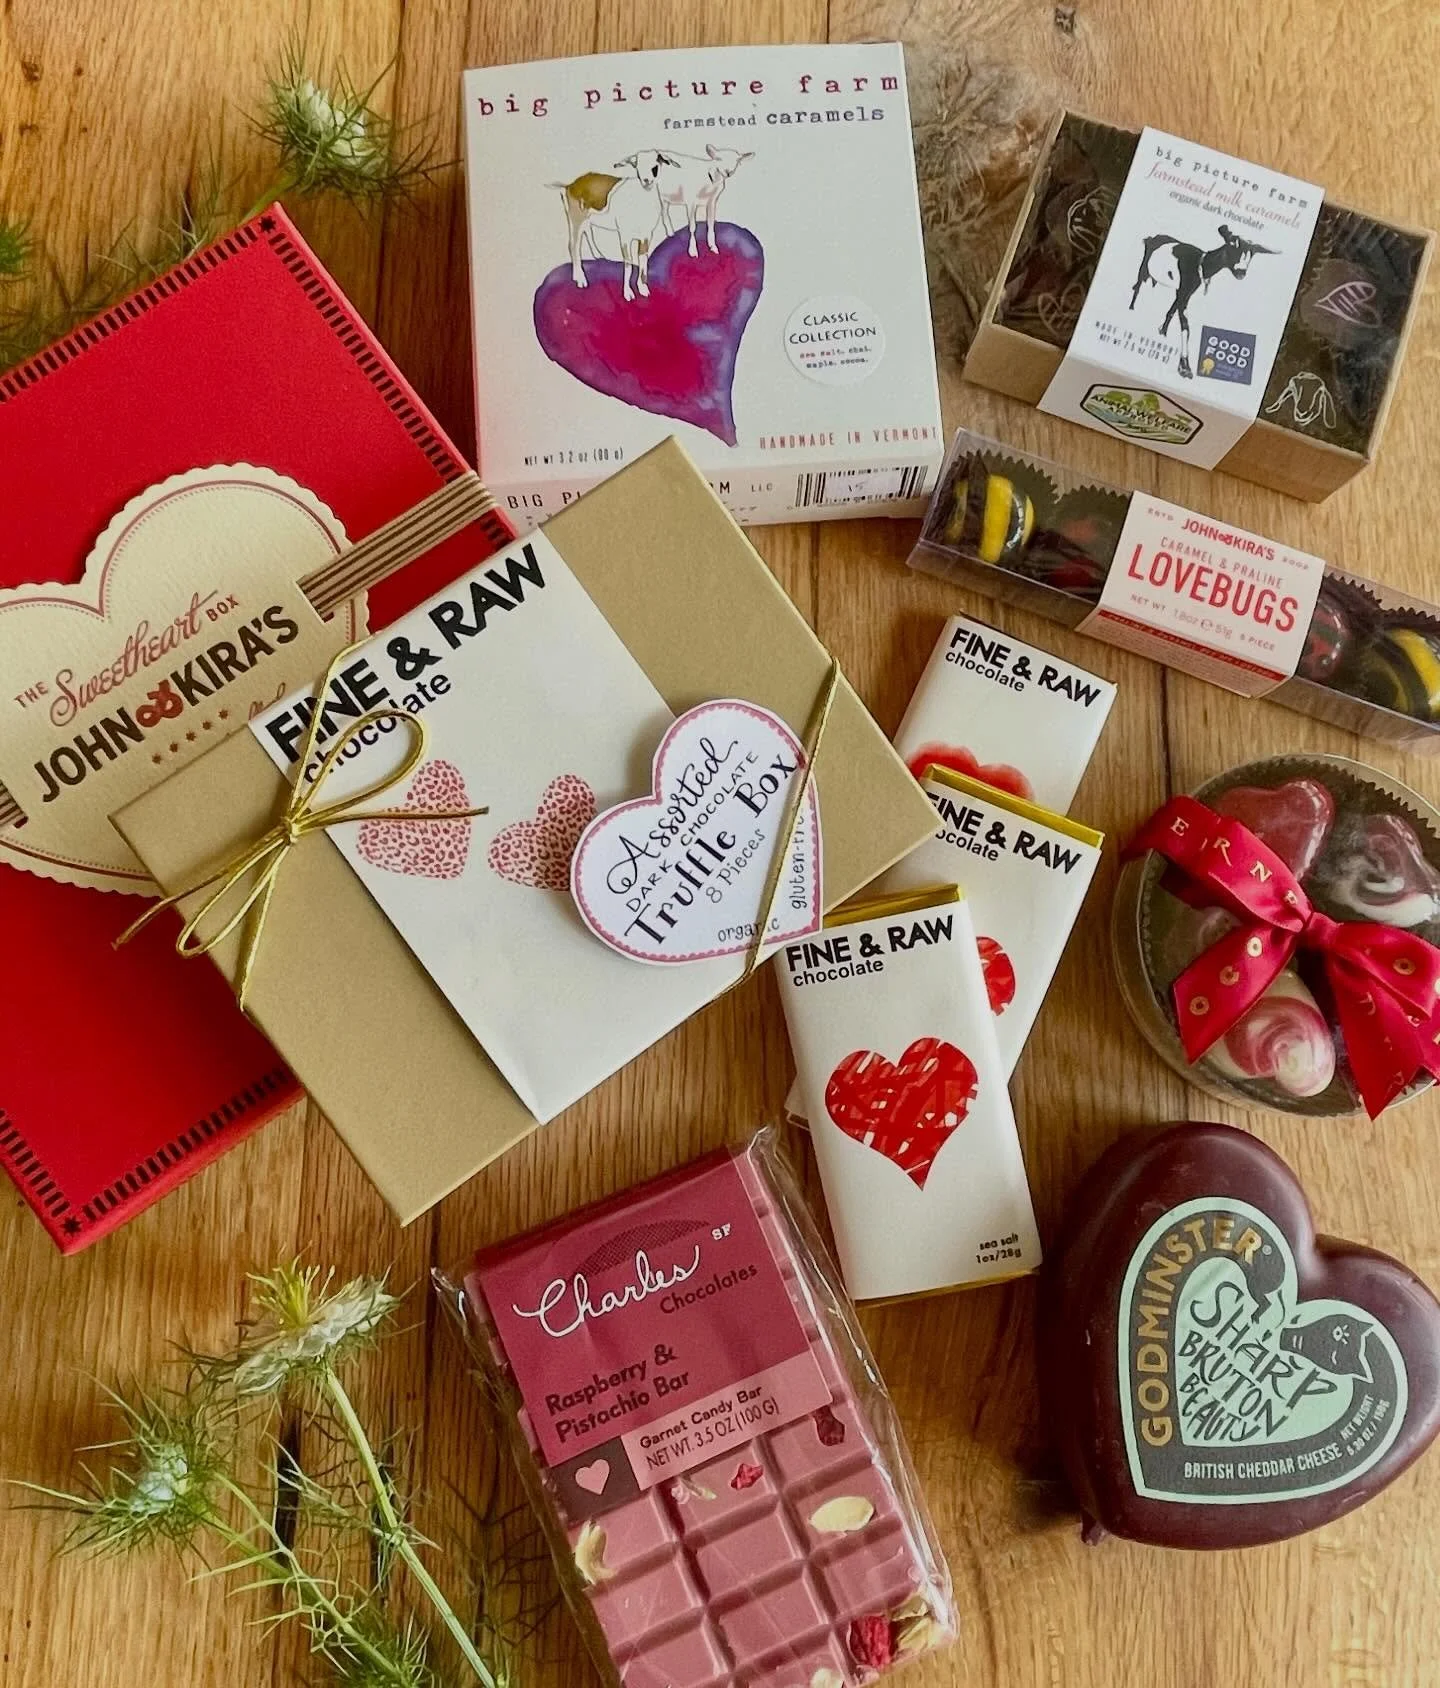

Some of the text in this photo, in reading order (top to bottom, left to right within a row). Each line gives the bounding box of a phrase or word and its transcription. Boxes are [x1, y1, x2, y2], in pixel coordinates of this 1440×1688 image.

[479, 73, 899, 117] big picture farm
[663, 106, 885, 131] farmstead caramels
[1146, 162, 1302, 230] farmstead milk caramels
[1156, 146, 1308, 209] big picture farm
[1169, 190, 1265, 230] organic dark chocolate
[789, 327, 877, 345] COLLECTION
[803, 312, 859, 326] CLASSIC
[1205, 346, 1248, 368] FOOD
[1208, 336, 1250, 358] GOOD
[524, 455, 538, 466] NET
[759, 426, 937, 450] HANDMADE IN VERMONT
[507, 493, 544, 510] BIG
[751, 482, 773, 493] LLC
[1127, 543, 1299, 632] LOVEBUGS
[1161, 535, 1284, 589] CARAMEL & PRALINE
[1130, 594, 1149, 606] NET
[1152, 602, 1167, 612] WT
[14, 681, 49, 709] THE
[50, 590, 218, 727] Sweetheart
[205, 594, 241, 623] BOX
[265, 543, 545, 764] FINE & RAW
[950, 626, 1101, 708] FINE & RAW
[1248, 636, 1277, 652] PIECE
[945, 650, 1026, 692] chocolate
[606, 737, 739, 894] Assorted
[626, 751, 759, 913] DARK CHOCOLATE
[623, 753, 798, 944] Truffle Box
[705, 828, 766, 904] 8 pieces
[935, 829, 1000, 861] ocolate
[985, 821, 1008, 849] &
[1012, 830, 1083, 874] RAW
[785, 915, 954, 972] FINE & RAW
[792, 957, 885, 988] chocolate
[711, 1223, 731, 1241] SF
[975, 1247, 1022, 1264] 1oz/28g
[979, 1232, 1019, 1250] sea salt
[512, 1245, 700, 1337] Charles
[659, 1262, 758, 1315] Chocolates
[1137, 1215, 1263, 1447] GODMINSTER
[1189, 1280, 1338, 1410] SHARP
[545, 1343, 679, 1417] Raspberry &
[555, 1370, 690, 1443] Pistachio Bar
[1178, 1329, 1290, 1439] BRUTON
[639, 1384, 762, 1449] Garnet Candy Bar
[646, 1396, 779, 1471] NET WT. 3.5 OZ (100 G)
[1179, 1372, 1262, 1442] BEAUTY
[1340, 1394, 1374, 1441] NET WEIGHT
[1184, 1441, 1345, 1479] BRITISH CHEDDAR CHEESE
